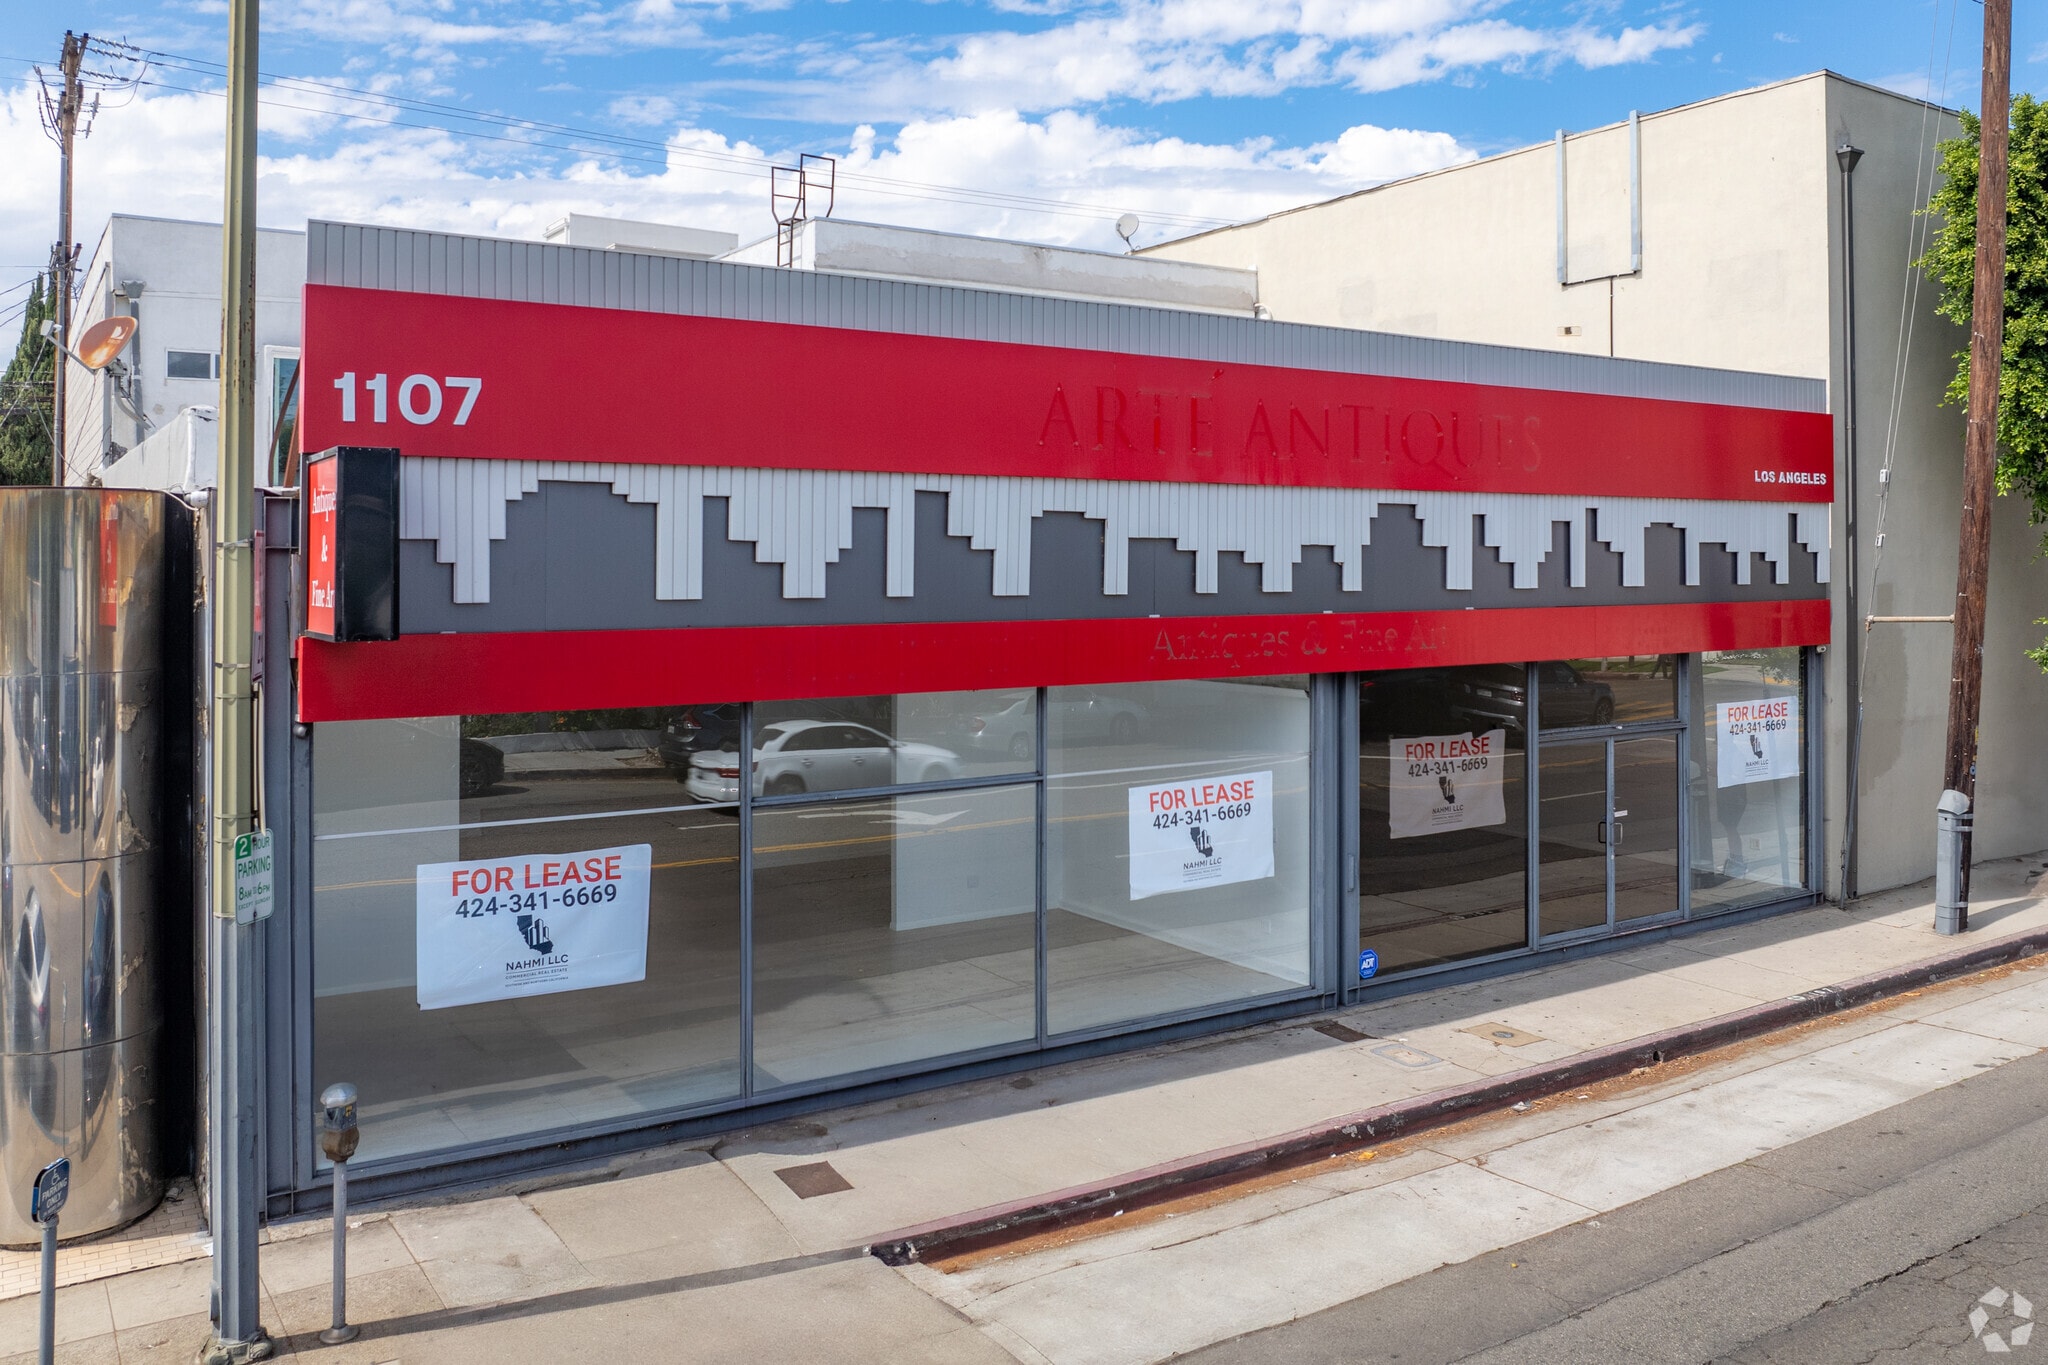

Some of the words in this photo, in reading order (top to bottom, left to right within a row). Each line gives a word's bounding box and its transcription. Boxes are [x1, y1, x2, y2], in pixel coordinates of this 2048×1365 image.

[334, 372, 482, 426] 1107
[1242, 396, 1543, 481] ANTIQUES
[1754, 470, 1776, 483] LOS
[1778, 471, 1827, 485] ANGELES
[321, 535, 328, 562] &
[312, 579, 326, 608] Fine
[326, 580, 335, 609] Ar
[1301, 620, 1328, 655] &
[1728, 706, 1749, 723] FOR
[1751, 702, 1788, 720] LEASE
[1730, 719, 1786, 735] 424-341-6669
[1405, 743, 1435, 762] FOR
[1440, 737, 1490, 759] LEASE
[1408, 757, 1488, 777] 424-341-6669
[1149, 788, 1187, 812] FOR
[1192, 780, 1255, 806] LEASE
[1153, 802, 1251, 829] 424-341-6669
[1432, 805, 1452, 815] NAHMI
[1452, 804, 1464, 812] LLC
[240, 838, 248, 856] 2
[237, 855, 271, 880] PARKING
[1183, 860, 1208, 870] NAHMI
[1209, 857, 1222, 866] LLC
[452, 866, 514, 897] FOR
[524, 855, 622, 889] LEASE
[238, 886, 252, 900] 8AM
[257, 881, 270, 895] 6PM
[455, 883, 617, 919] 424-341-6669
[505, 959, 545, 971] NAHMI
[548, 954, 569, 965] LLC
[1361, 957, 1375, 970] ADT
[42, 1178, 67, 1200] PARKING
[47, 1191, 61, 1208] ONLY
